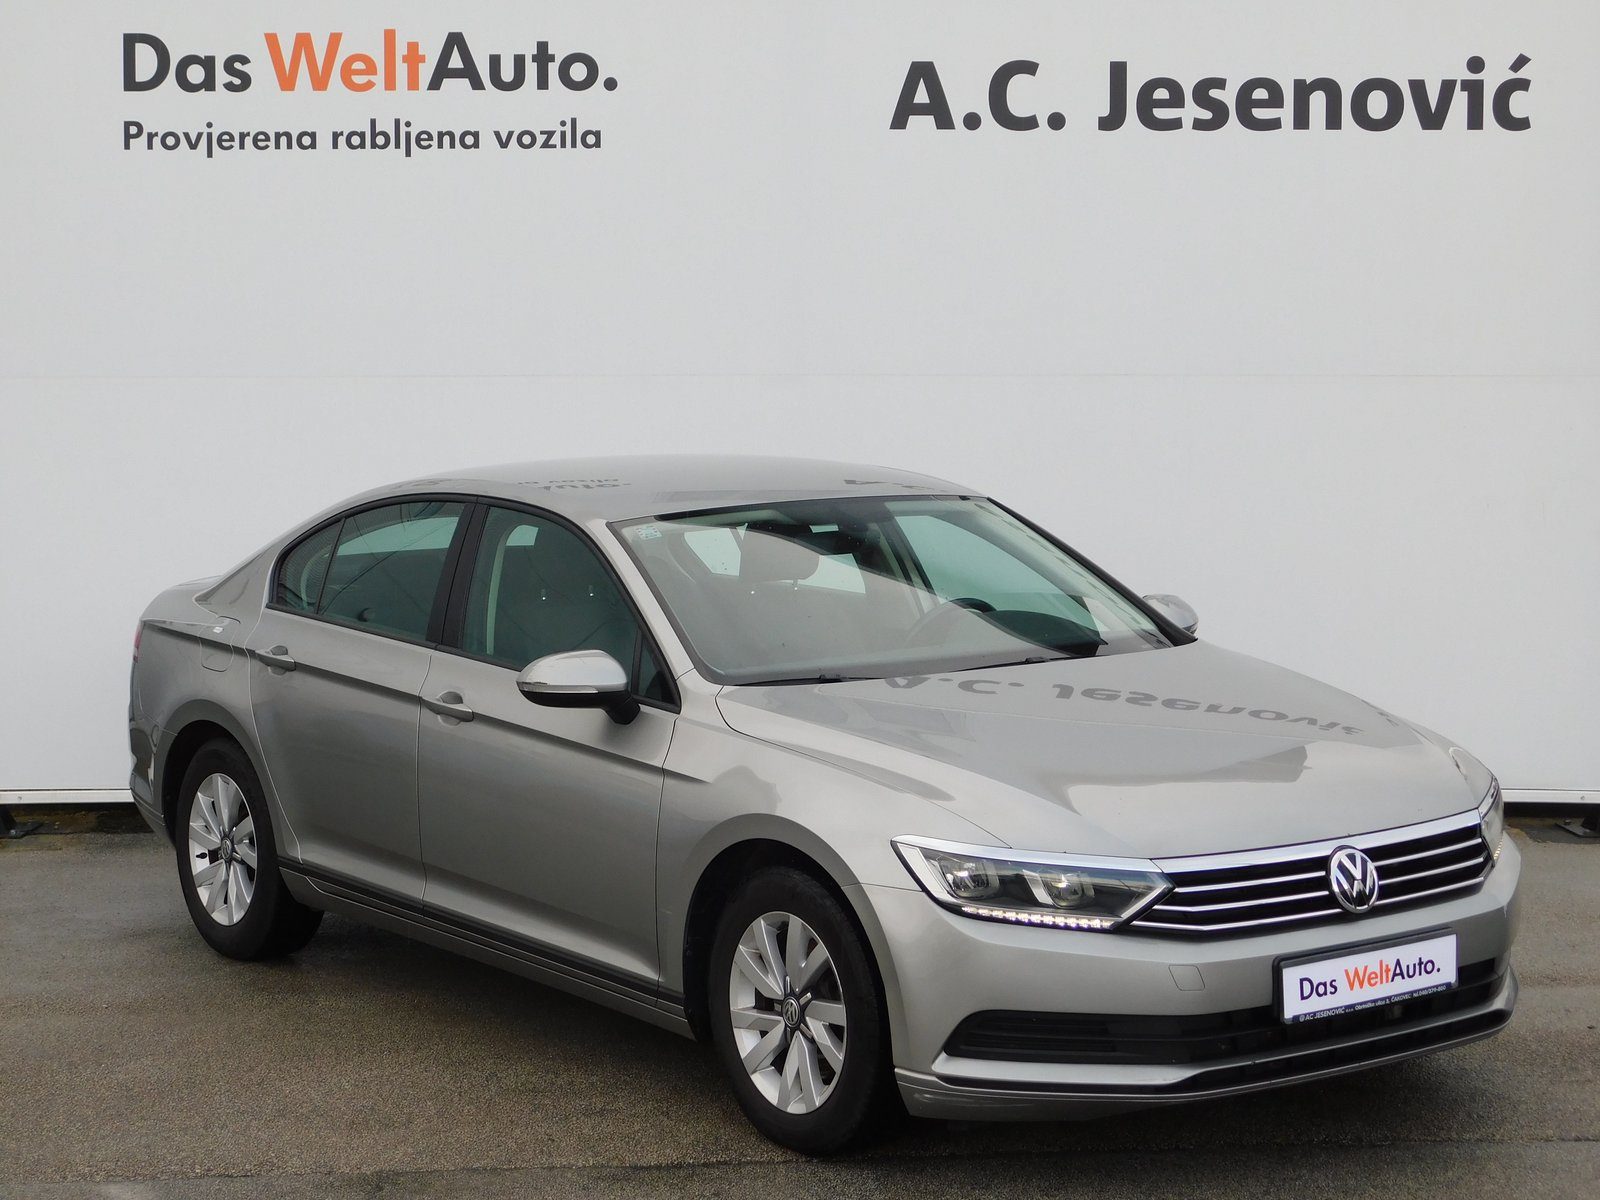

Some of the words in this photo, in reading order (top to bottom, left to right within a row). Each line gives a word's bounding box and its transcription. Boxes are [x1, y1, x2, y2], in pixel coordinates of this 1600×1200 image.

[122, 33, 252, 93] Das
[264, 29, 618, 93] WeltAuto.
[889, 60, 1067, 132] A.C.
[1098, 53, 1532, 132] Jesenović
[123, 121, 317, 158] Provjerena
[332, 118, 480, 157] rabljena
[493, 118, 602, 149] vozila
[1299, 976, 1338, 1001] Das
[1344, 957, 1441, 991] WeltAuto.
